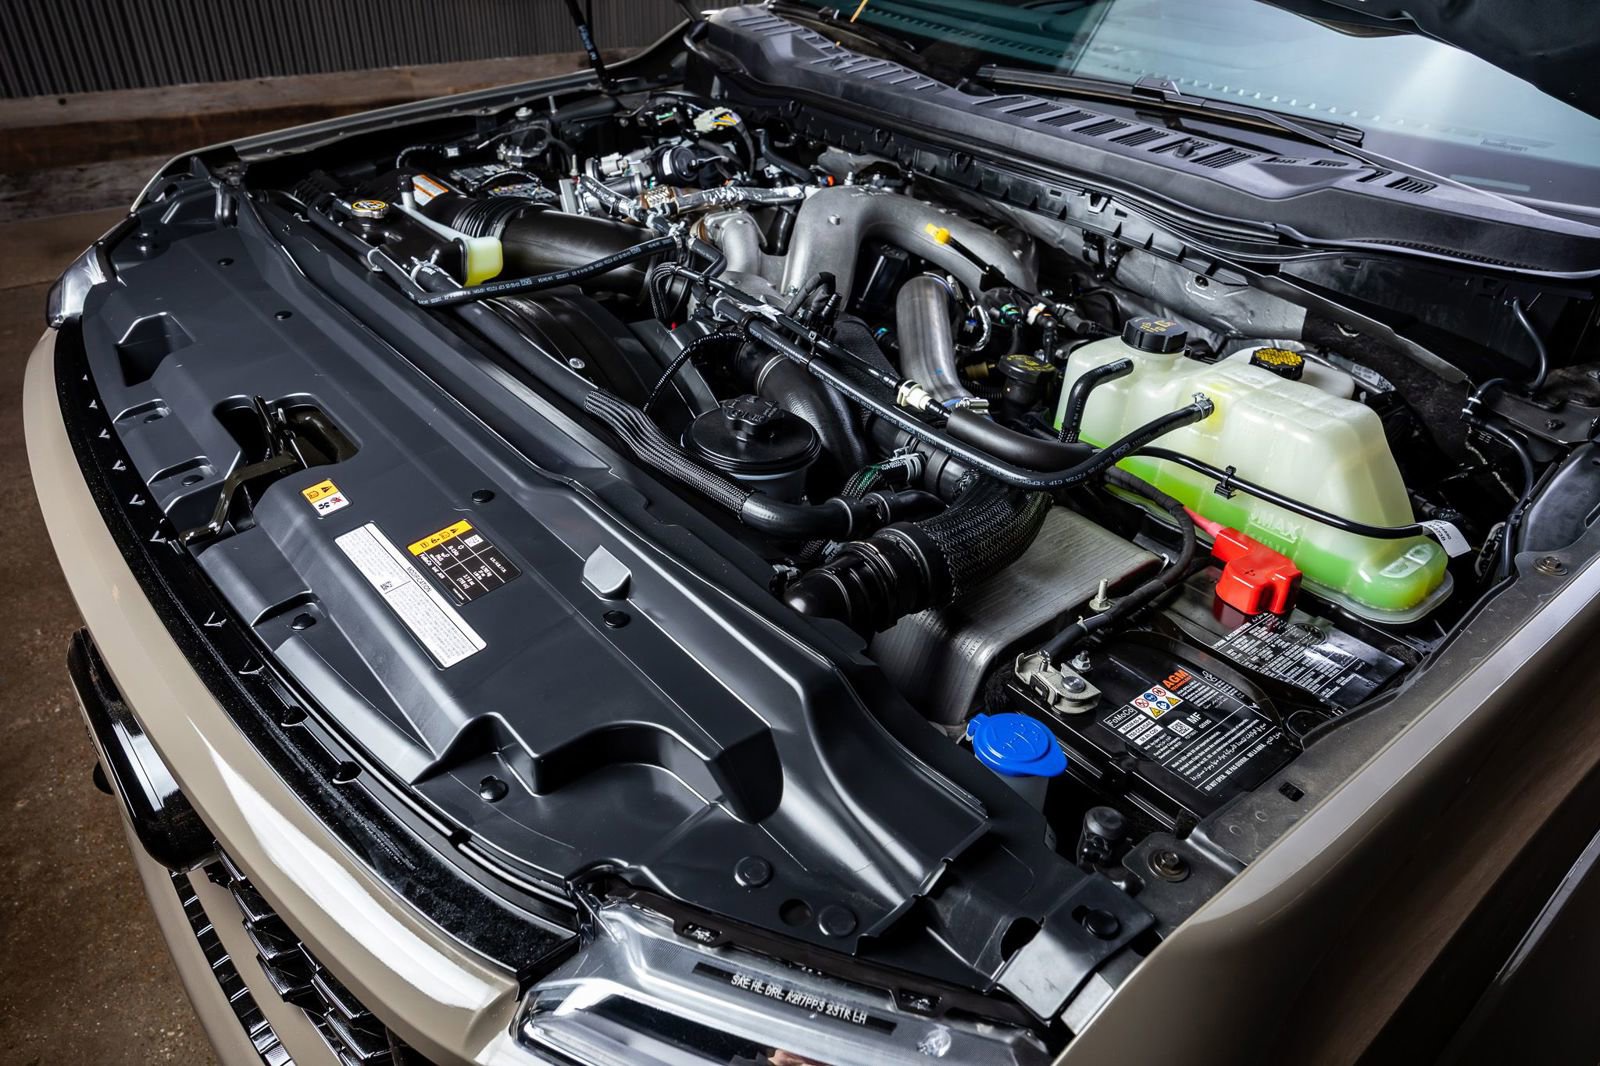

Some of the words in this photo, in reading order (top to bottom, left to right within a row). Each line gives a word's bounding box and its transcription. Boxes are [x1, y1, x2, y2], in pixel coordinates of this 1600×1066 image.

[407, 566, 431, 592] MODIFICATION
[1162, 669, 1189, 688] AGM
[1107, 707, 1135, 727] FoMoCo
[1186, 712, 1201, 724] MF
[731, 974, 751, 989] SAE
[852, 1009, 868, 1024] LH
